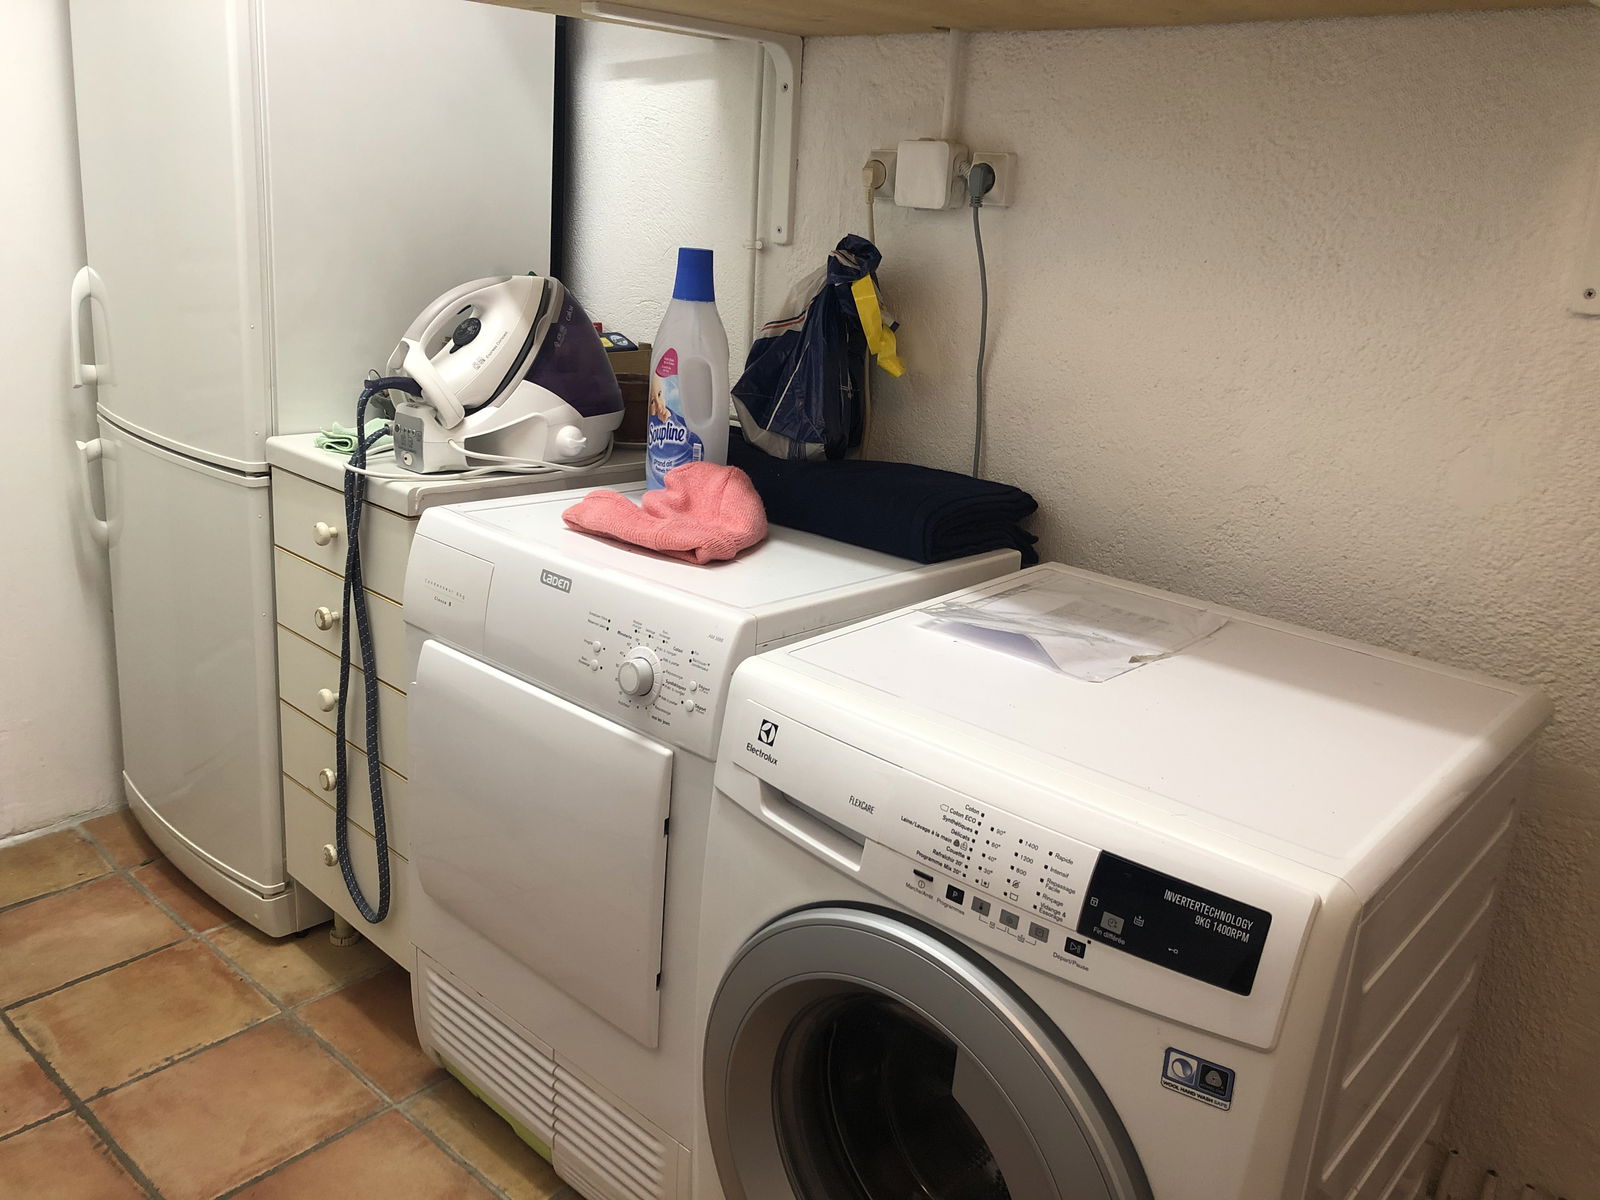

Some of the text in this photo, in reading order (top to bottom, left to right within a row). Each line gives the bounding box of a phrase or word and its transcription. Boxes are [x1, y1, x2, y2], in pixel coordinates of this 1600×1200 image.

[649, 421, 685, 446] Soupline
[746, 742, 779, 766] Electrolux
[949, 807, 977, 824] Coton ECO
[965, 804, 980, 815] Coton
[942, 815, 973, 833] Synthétiques
[950, 828, 970, 841] Délicats
[946, 845, 965, 859] Couette
[1025, 841, 1039, 851] 1400
[916, 850, 943, 867] Programme
[1020, 854, 1034, 864] 1200
[1054, 852, 1074, 865] Rapide
[1015, 867, 1027, 877] 800
[1049, 866, 1070, 879] Intensif
[1045, 883, 1061, 894] Facile
[1047, 877, 1076, 895] Repassage
[936, 897, 965, 916] Programmes
[1042, 893, 1064, 907] Rinçage
[1039, 907, 1064, 923] Essorage
[1040, 902, 1061, 916] Vidange
[1163, 889, 1254, 931] INVERTERTECHNOLOGY
[1092, 926, 1103, 937] Fin
[1194, 915, 1250, 944] 9KG 1400RPM
[1162, 1080, 1180, 1091] WOOL
[1180, 1086, 1196, 1096] HAND
[1197, 1093, 1214, 1104] WASH
[1213, 1098, 1228, 1109] SAFE
